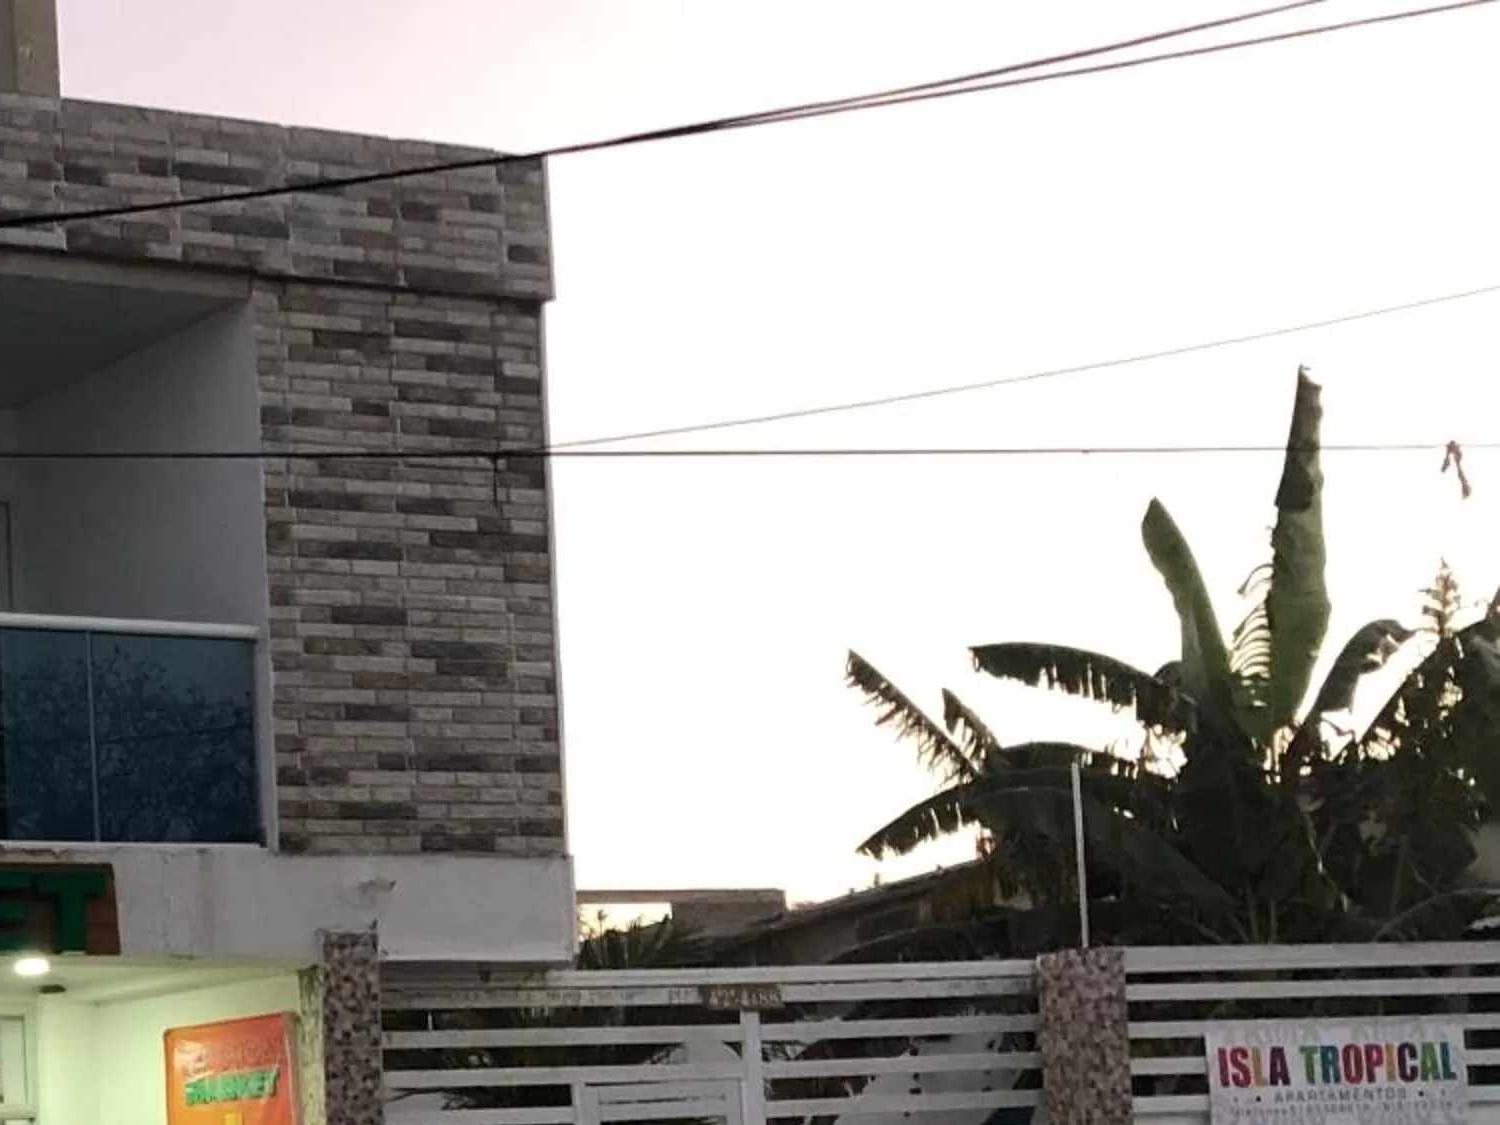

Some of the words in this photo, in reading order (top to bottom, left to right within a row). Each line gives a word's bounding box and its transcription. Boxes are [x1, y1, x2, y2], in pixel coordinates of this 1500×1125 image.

[1217, 1047, 1291, 1088] ISLA
[1299, 1041, 1457, 1085] TROPICAL
[1273, 1086, 1408, 1104] APARTAMENTOS
